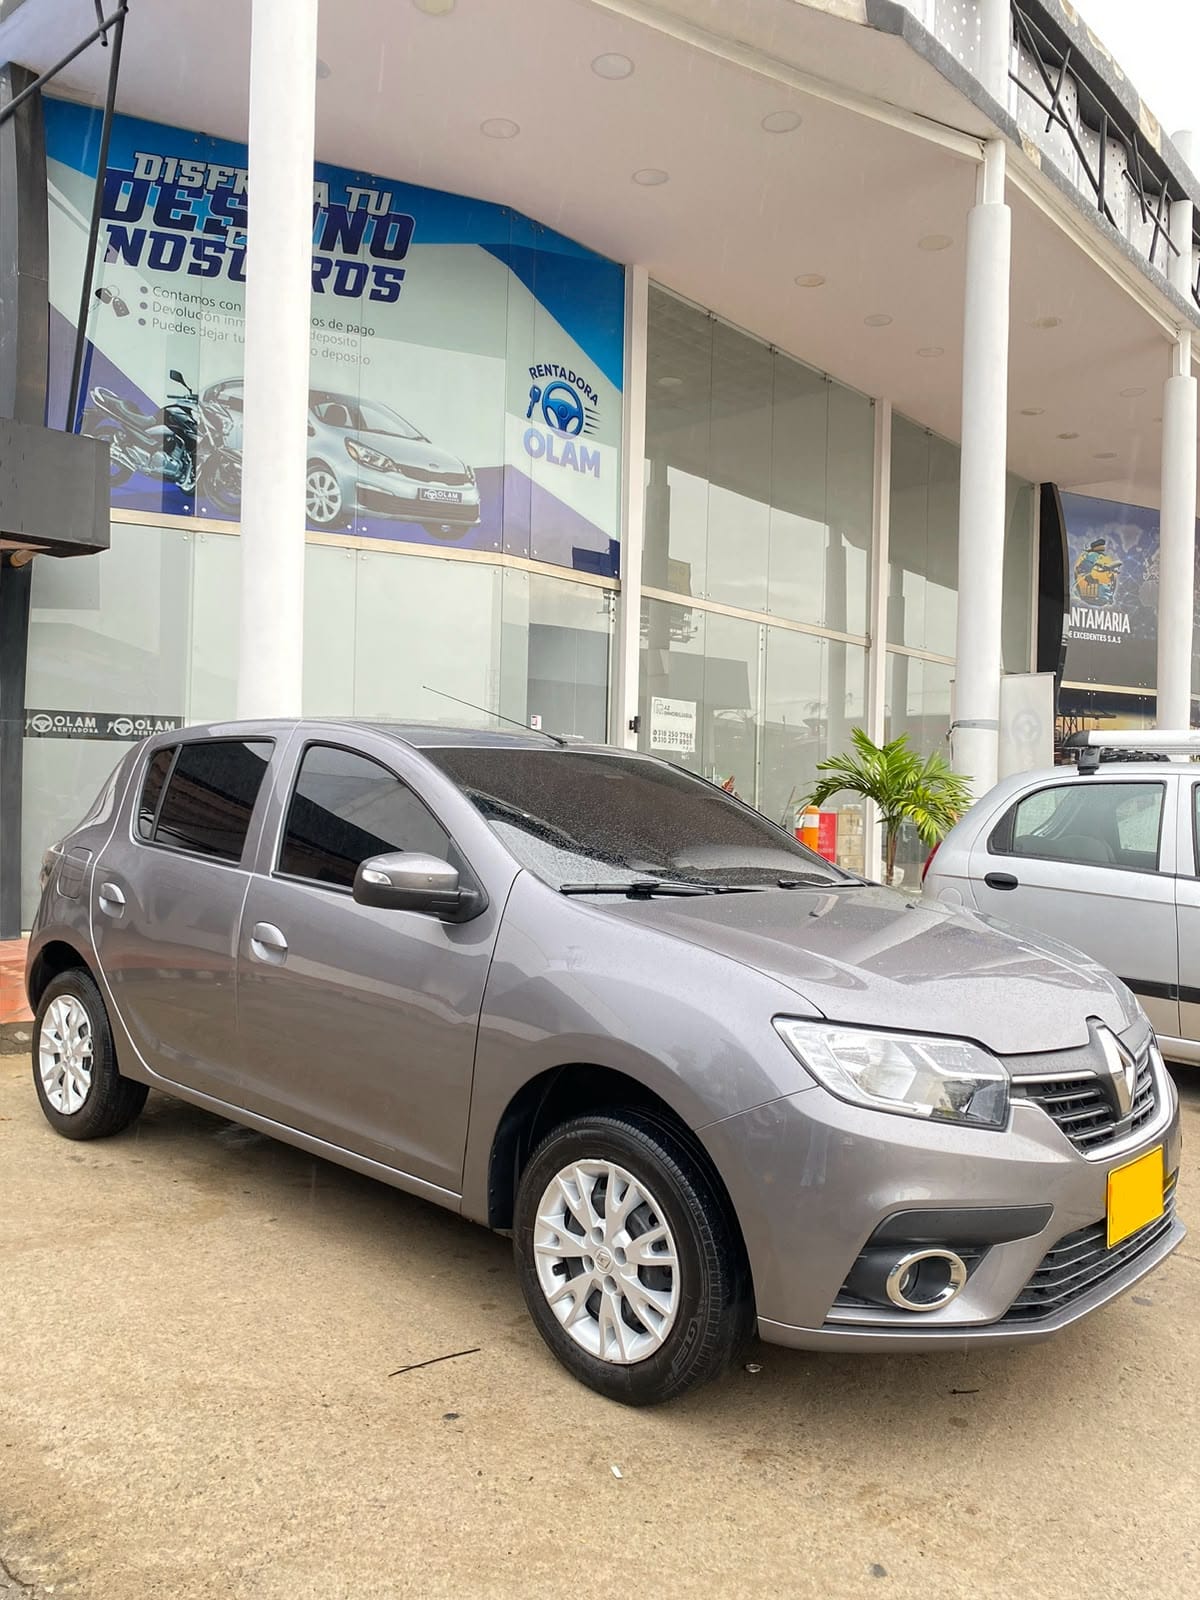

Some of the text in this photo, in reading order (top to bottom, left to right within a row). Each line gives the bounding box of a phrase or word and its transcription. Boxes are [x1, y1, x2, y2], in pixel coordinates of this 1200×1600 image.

[134, 152, 392, 216] DISFRA TU
[100, 167, 415, 261] DESNO
[103, 224, 405, 303] NOSROS
[152, 286, 216, 307] Contamos
[219, 300, 242, 312] con
[328, 319, 343, 331] de
[346, 323, 375, 337] pago
[152, 301, 220, 324] Devolución
[152, 317, 196, 336] Puedes
[199, 326, 229, 341] dejar
[321, 347, 371, 365] deposito
[528, 363, 599, 406] RENTADORA
[523, 427, 601, 479] OLAM
[437, 491, 458, 499] OLAM
[1073, 631, 1107, 642] EXCEDENTES
[52, 726, 99, 734] RENTADORA
[54, 716, 176, 732] OLAM OLAM
